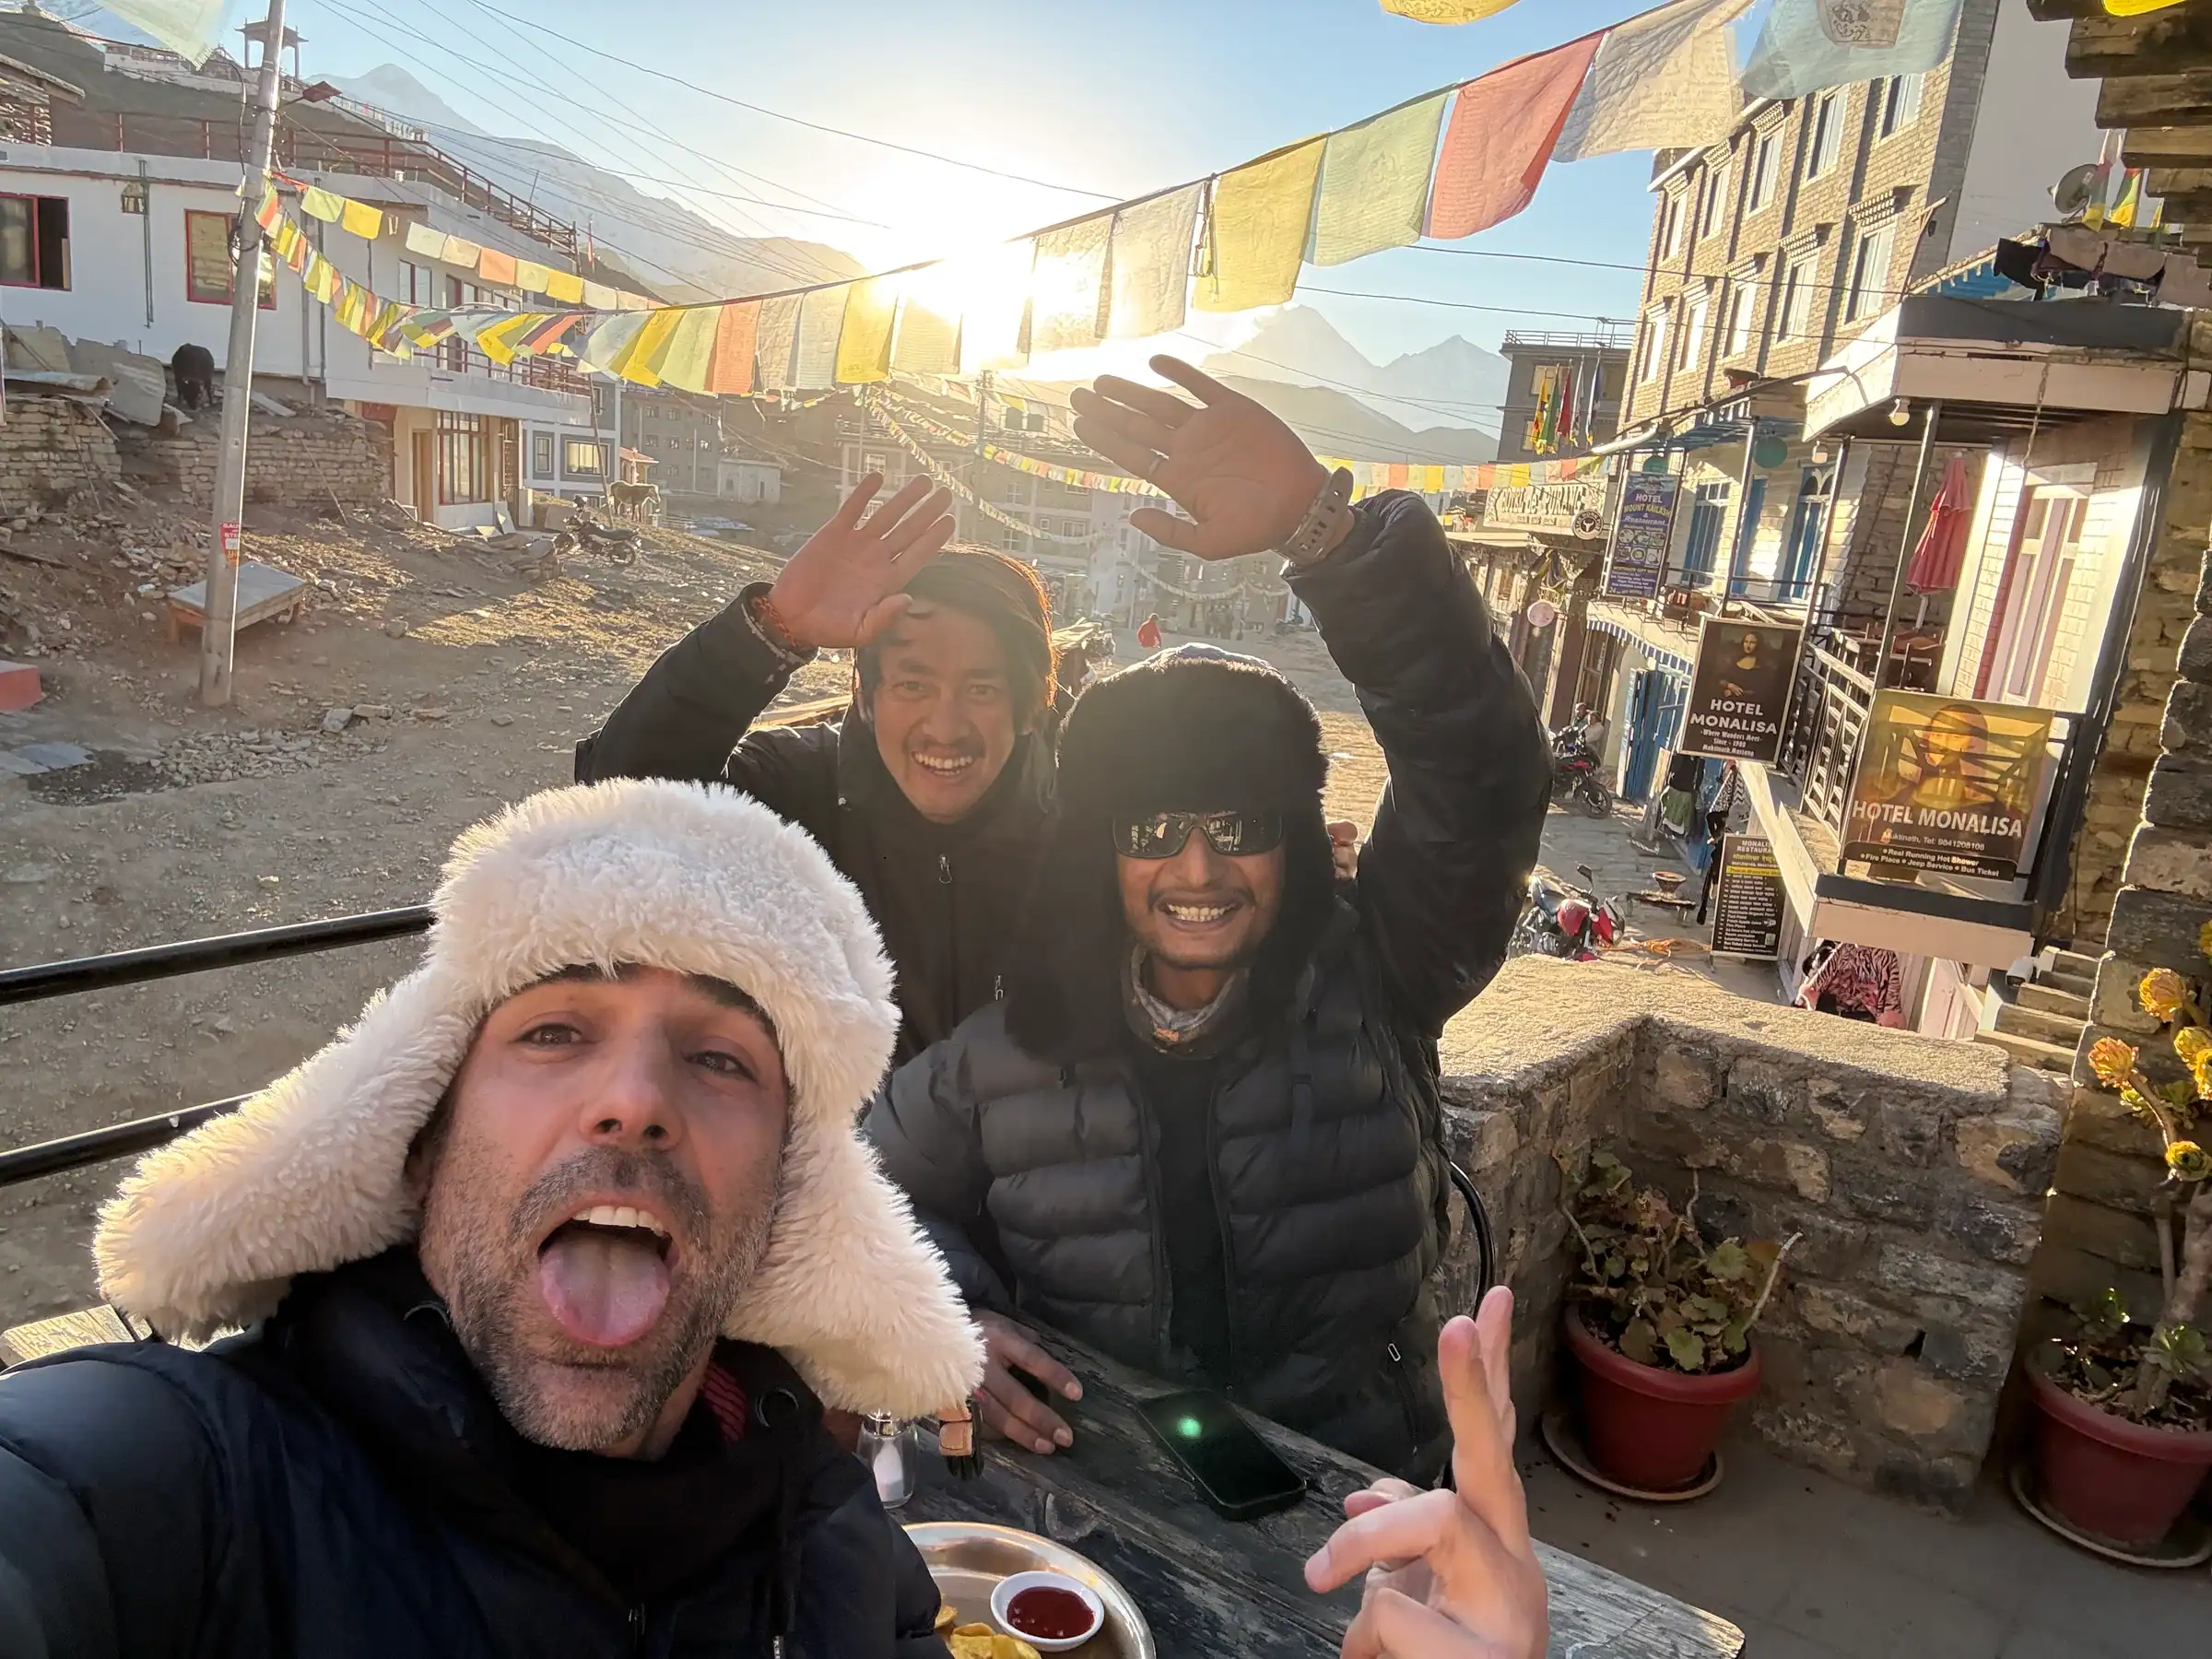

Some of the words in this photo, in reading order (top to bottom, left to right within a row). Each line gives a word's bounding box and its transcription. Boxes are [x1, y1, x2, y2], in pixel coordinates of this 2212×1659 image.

[1635, 493, 1663, 503] HOTEL
[1623, 503, 1646, 513] MOUNT
[1646, 504, 1672, 517] KAILASH
[1624, 515, 1666, 525] Restaurant
[1710, 699, 1764, 716] HOTEL
[1689, 712, 1778, 735] MONALISA
[1852, 800, 1913, 825] HOTEL
[1917, 807, 2023, 838] MONALISA
[1882, 831, 1922, 843] Muktinath,
[1924, 836, 1936, 845] Tel:
[1736, 845, 1771, 853] RESTAURA
[1888, 848, 1904, 856] Real
[1905, 851, 1936, 862] Running
[1936, 854, 1950, 863] Hot
[1950, 856, 1980, 866] Shower
[1865, 853, 1879, 862] Fire
[1880, 855, 1900, 865] Place
[1907, 859, 1925, 868] Jeep
[1926, 861, 1953, 871] Service
[1960, 865, 1975, 874] Bus
[1977, 867, 1999, 877] Ticket
